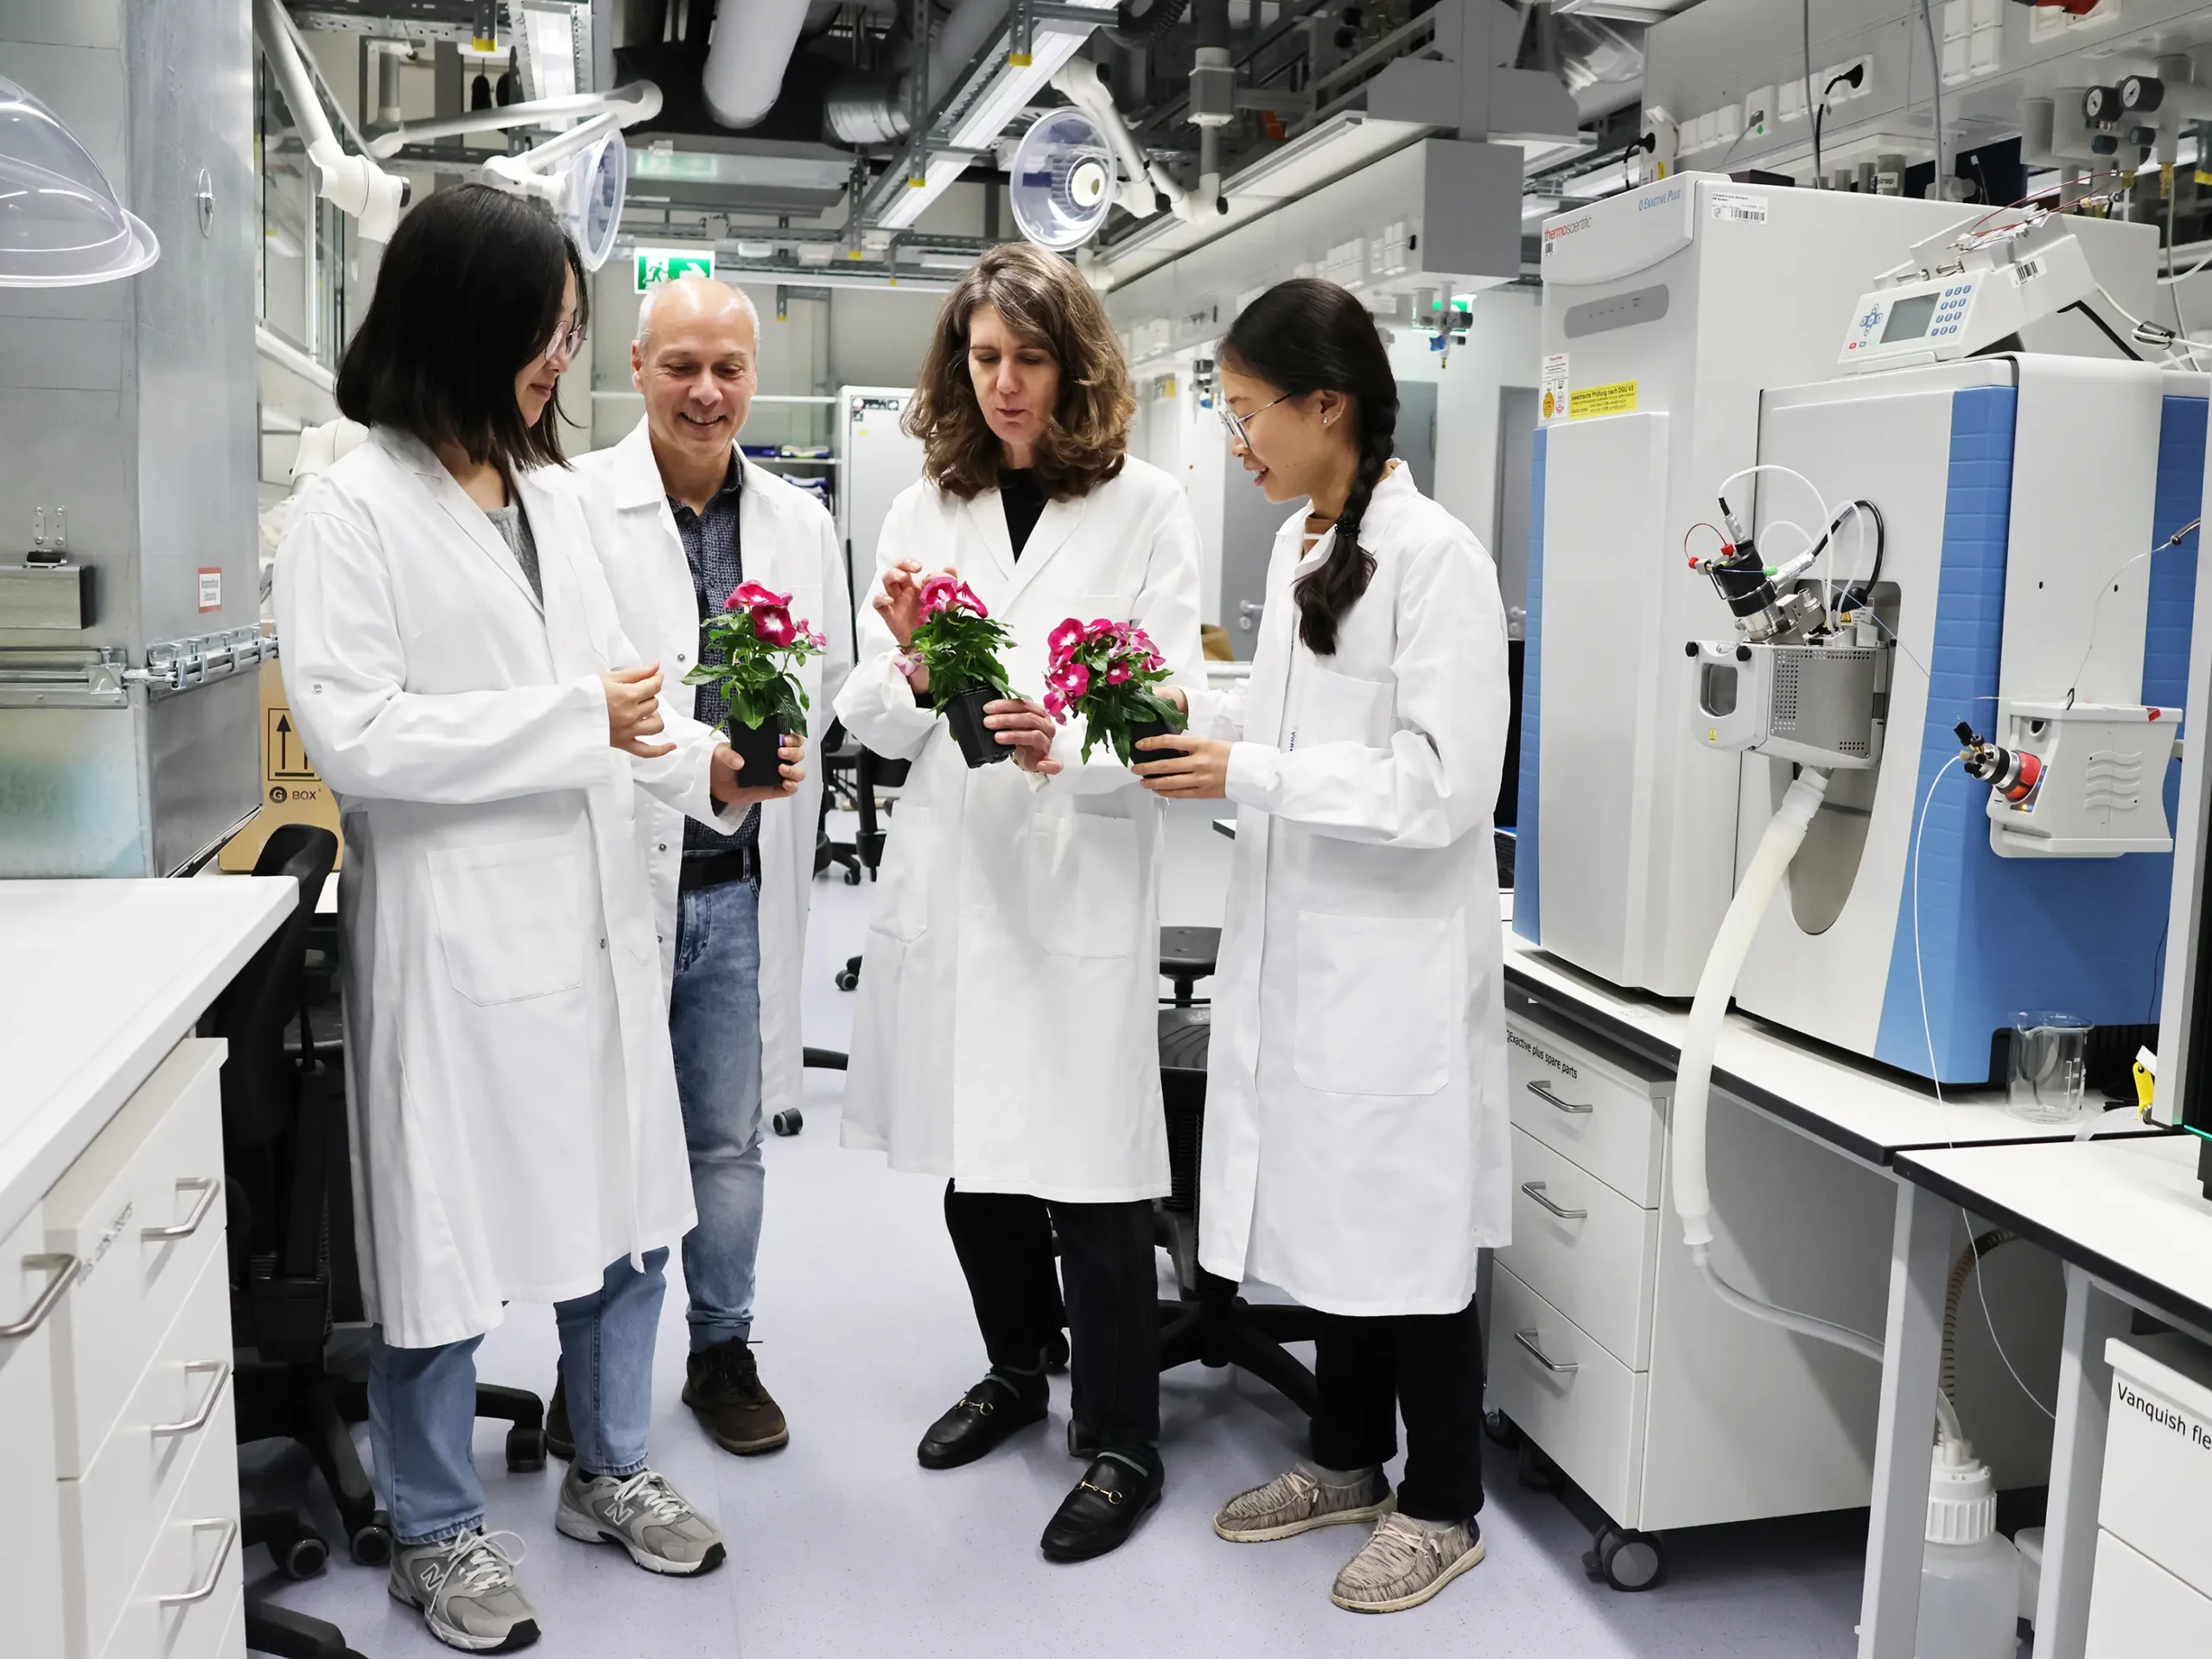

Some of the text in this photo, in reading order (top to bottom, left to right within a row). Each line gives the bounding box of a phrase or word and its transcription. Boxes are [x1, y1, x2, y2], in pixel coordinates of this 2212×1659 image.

[292, 791, 317, 800] BOX
[1532, 1046, 1544, 1060] plus
[1545, 1053, 1561, 1070] spare
[1561, 1063, 1578, 1079] parts
[2118, 1382, 2186, 1436] Vanquish
